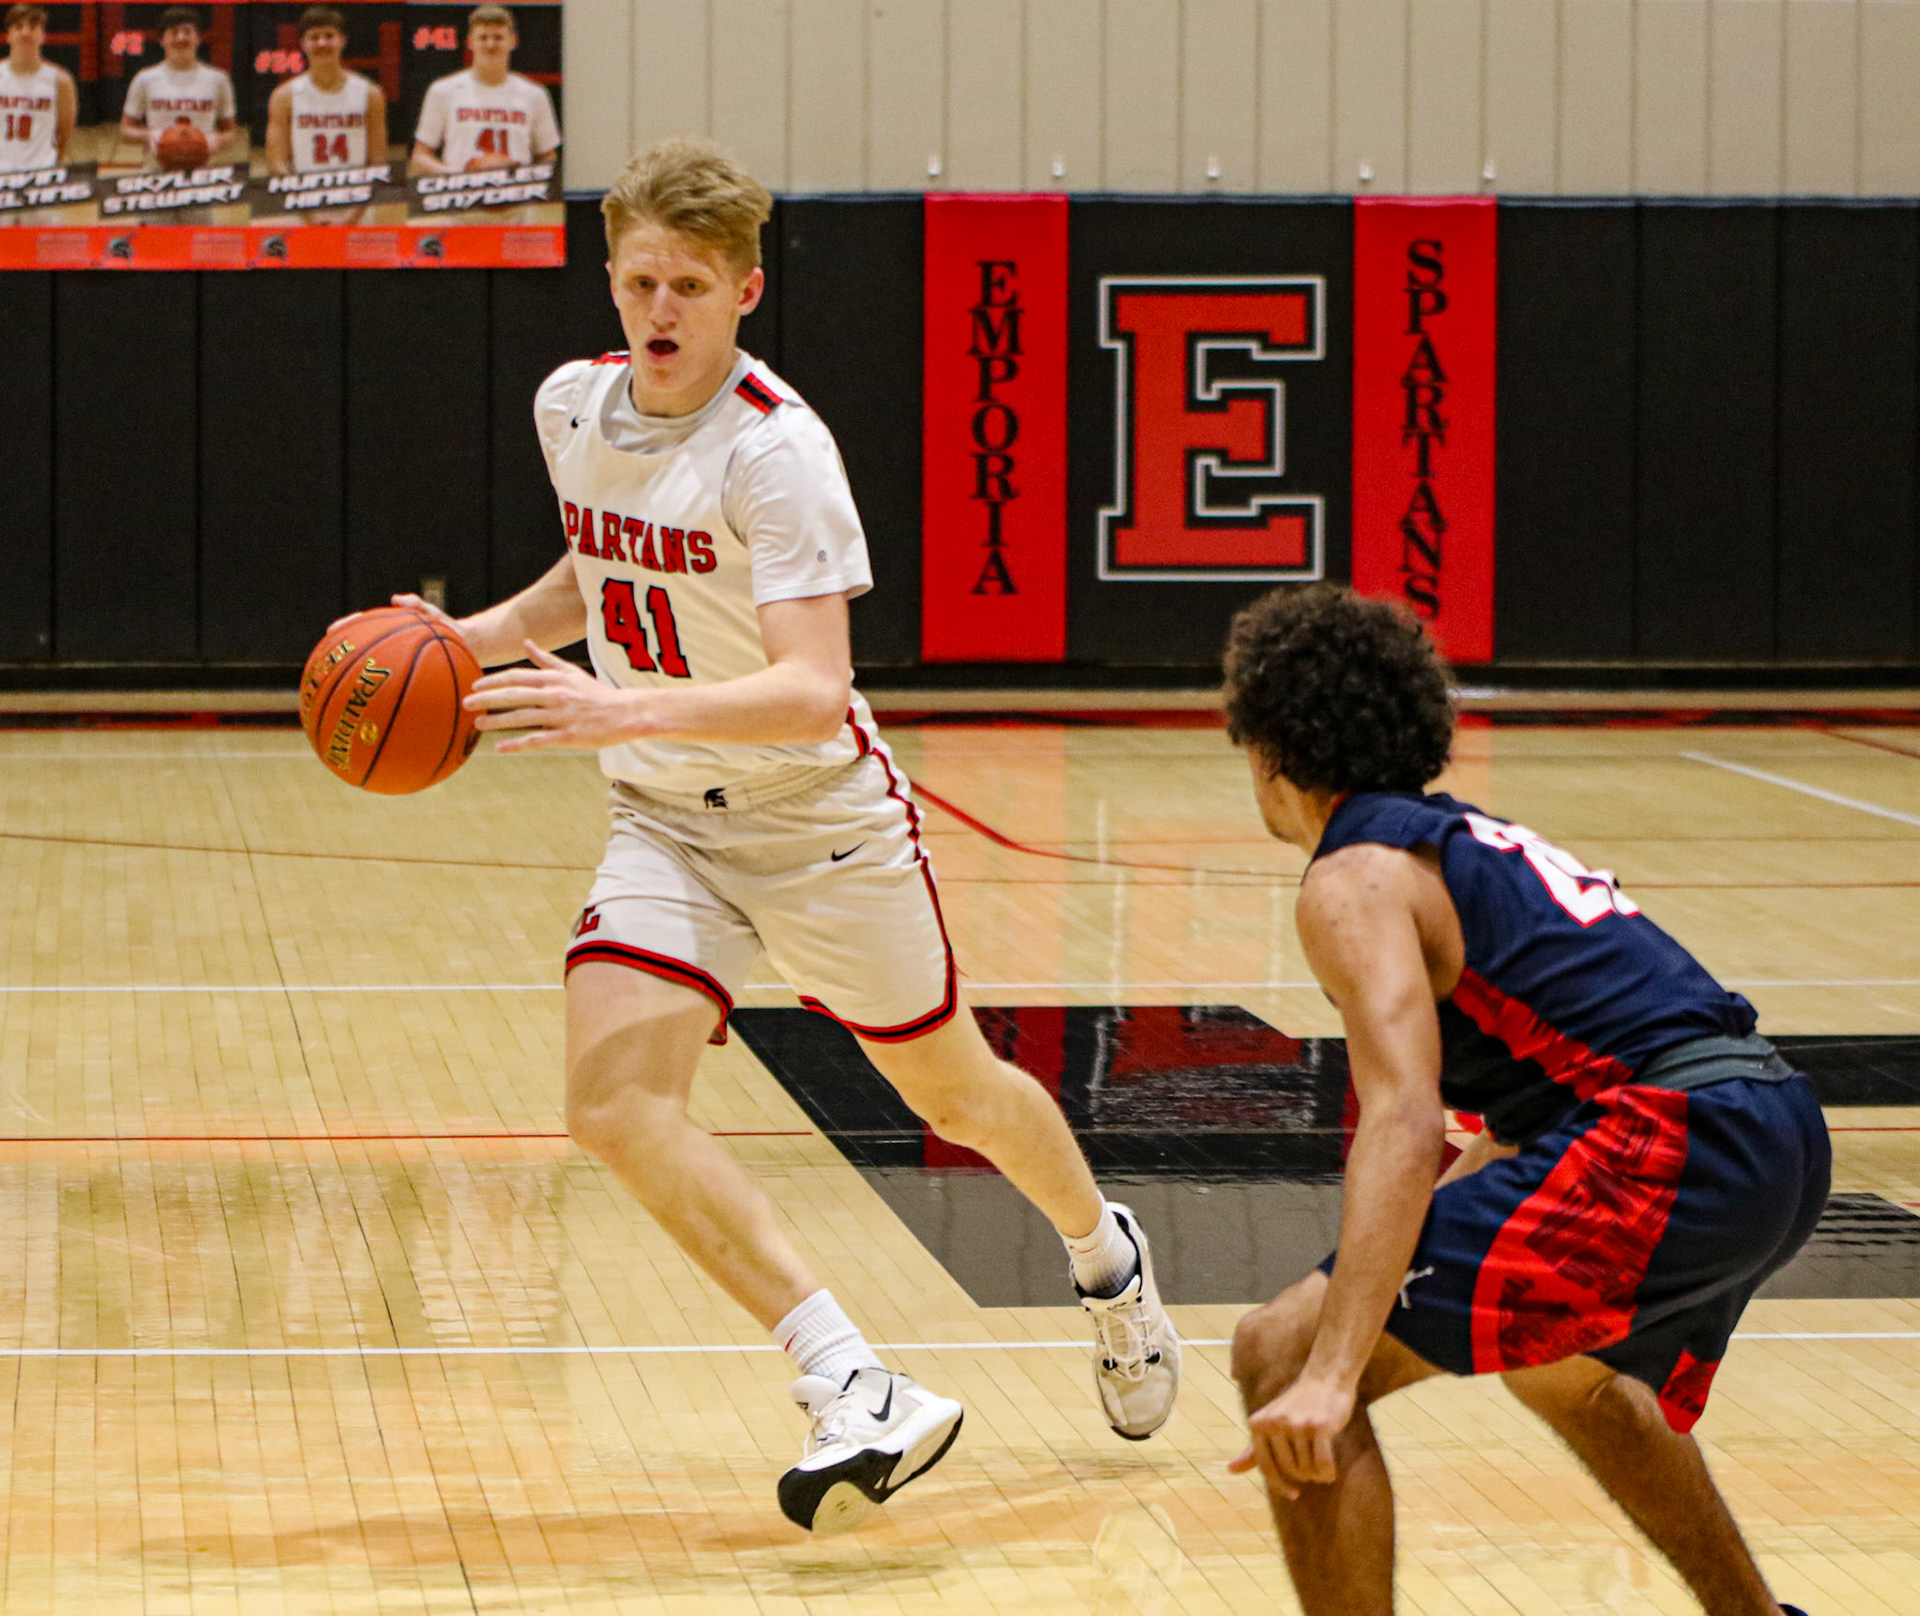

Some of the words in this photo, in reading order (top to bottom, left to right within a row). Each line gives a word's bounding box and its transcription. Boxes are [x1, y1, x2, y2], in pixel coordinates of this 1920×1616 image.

[5, 114, 32, 141] 10
[476, 128, 509, 155] 41
[312, 134, 349, 163] 24
[117, 167, 235, 194] SKYLER
[268, 165, 391, 193] HUNTER
[416, 164, 554, 194] CHARLES
[103, 183, 245, 213] STEWART
[284, 184, 373, 210] HINES
[422, 182, 549, 211] SNYDER
[966, 261, 1026, 596] EMPORIA
[1098, 274, 1327, 582] E
[1399, 239, 1448, 614] SPARTANS
[601, 577, 691, 679] 41
[325, 657, 392, 772] SPALDING
